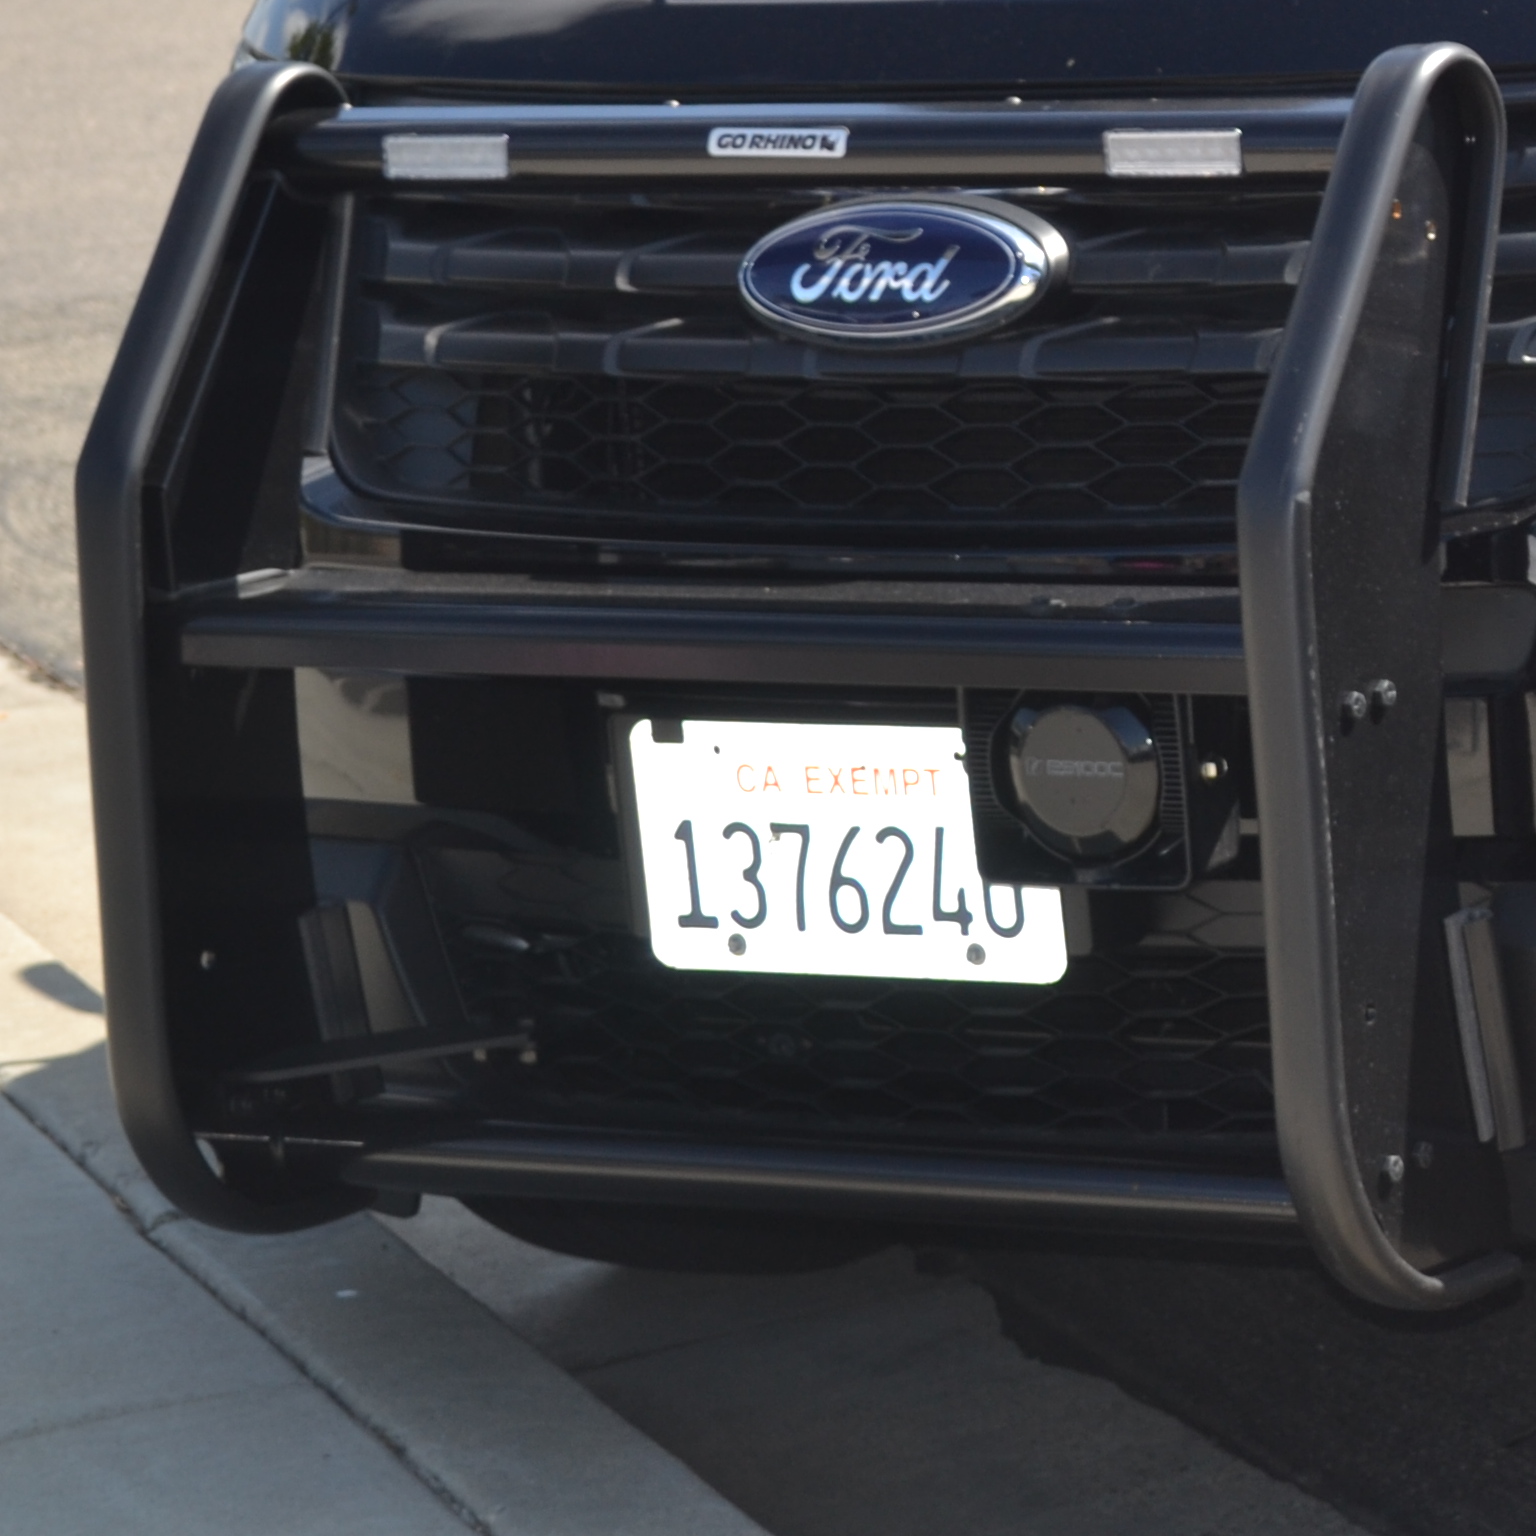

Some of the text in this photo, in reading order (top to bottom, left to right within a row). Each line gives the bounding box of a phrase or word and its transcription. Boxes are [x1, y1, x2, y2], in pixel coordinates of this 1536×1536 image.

[748, 133, 817, 150] RHINO
[790, 224, 961, 303] Ford
[736, 764, 941, 796] CA EXEMPT
